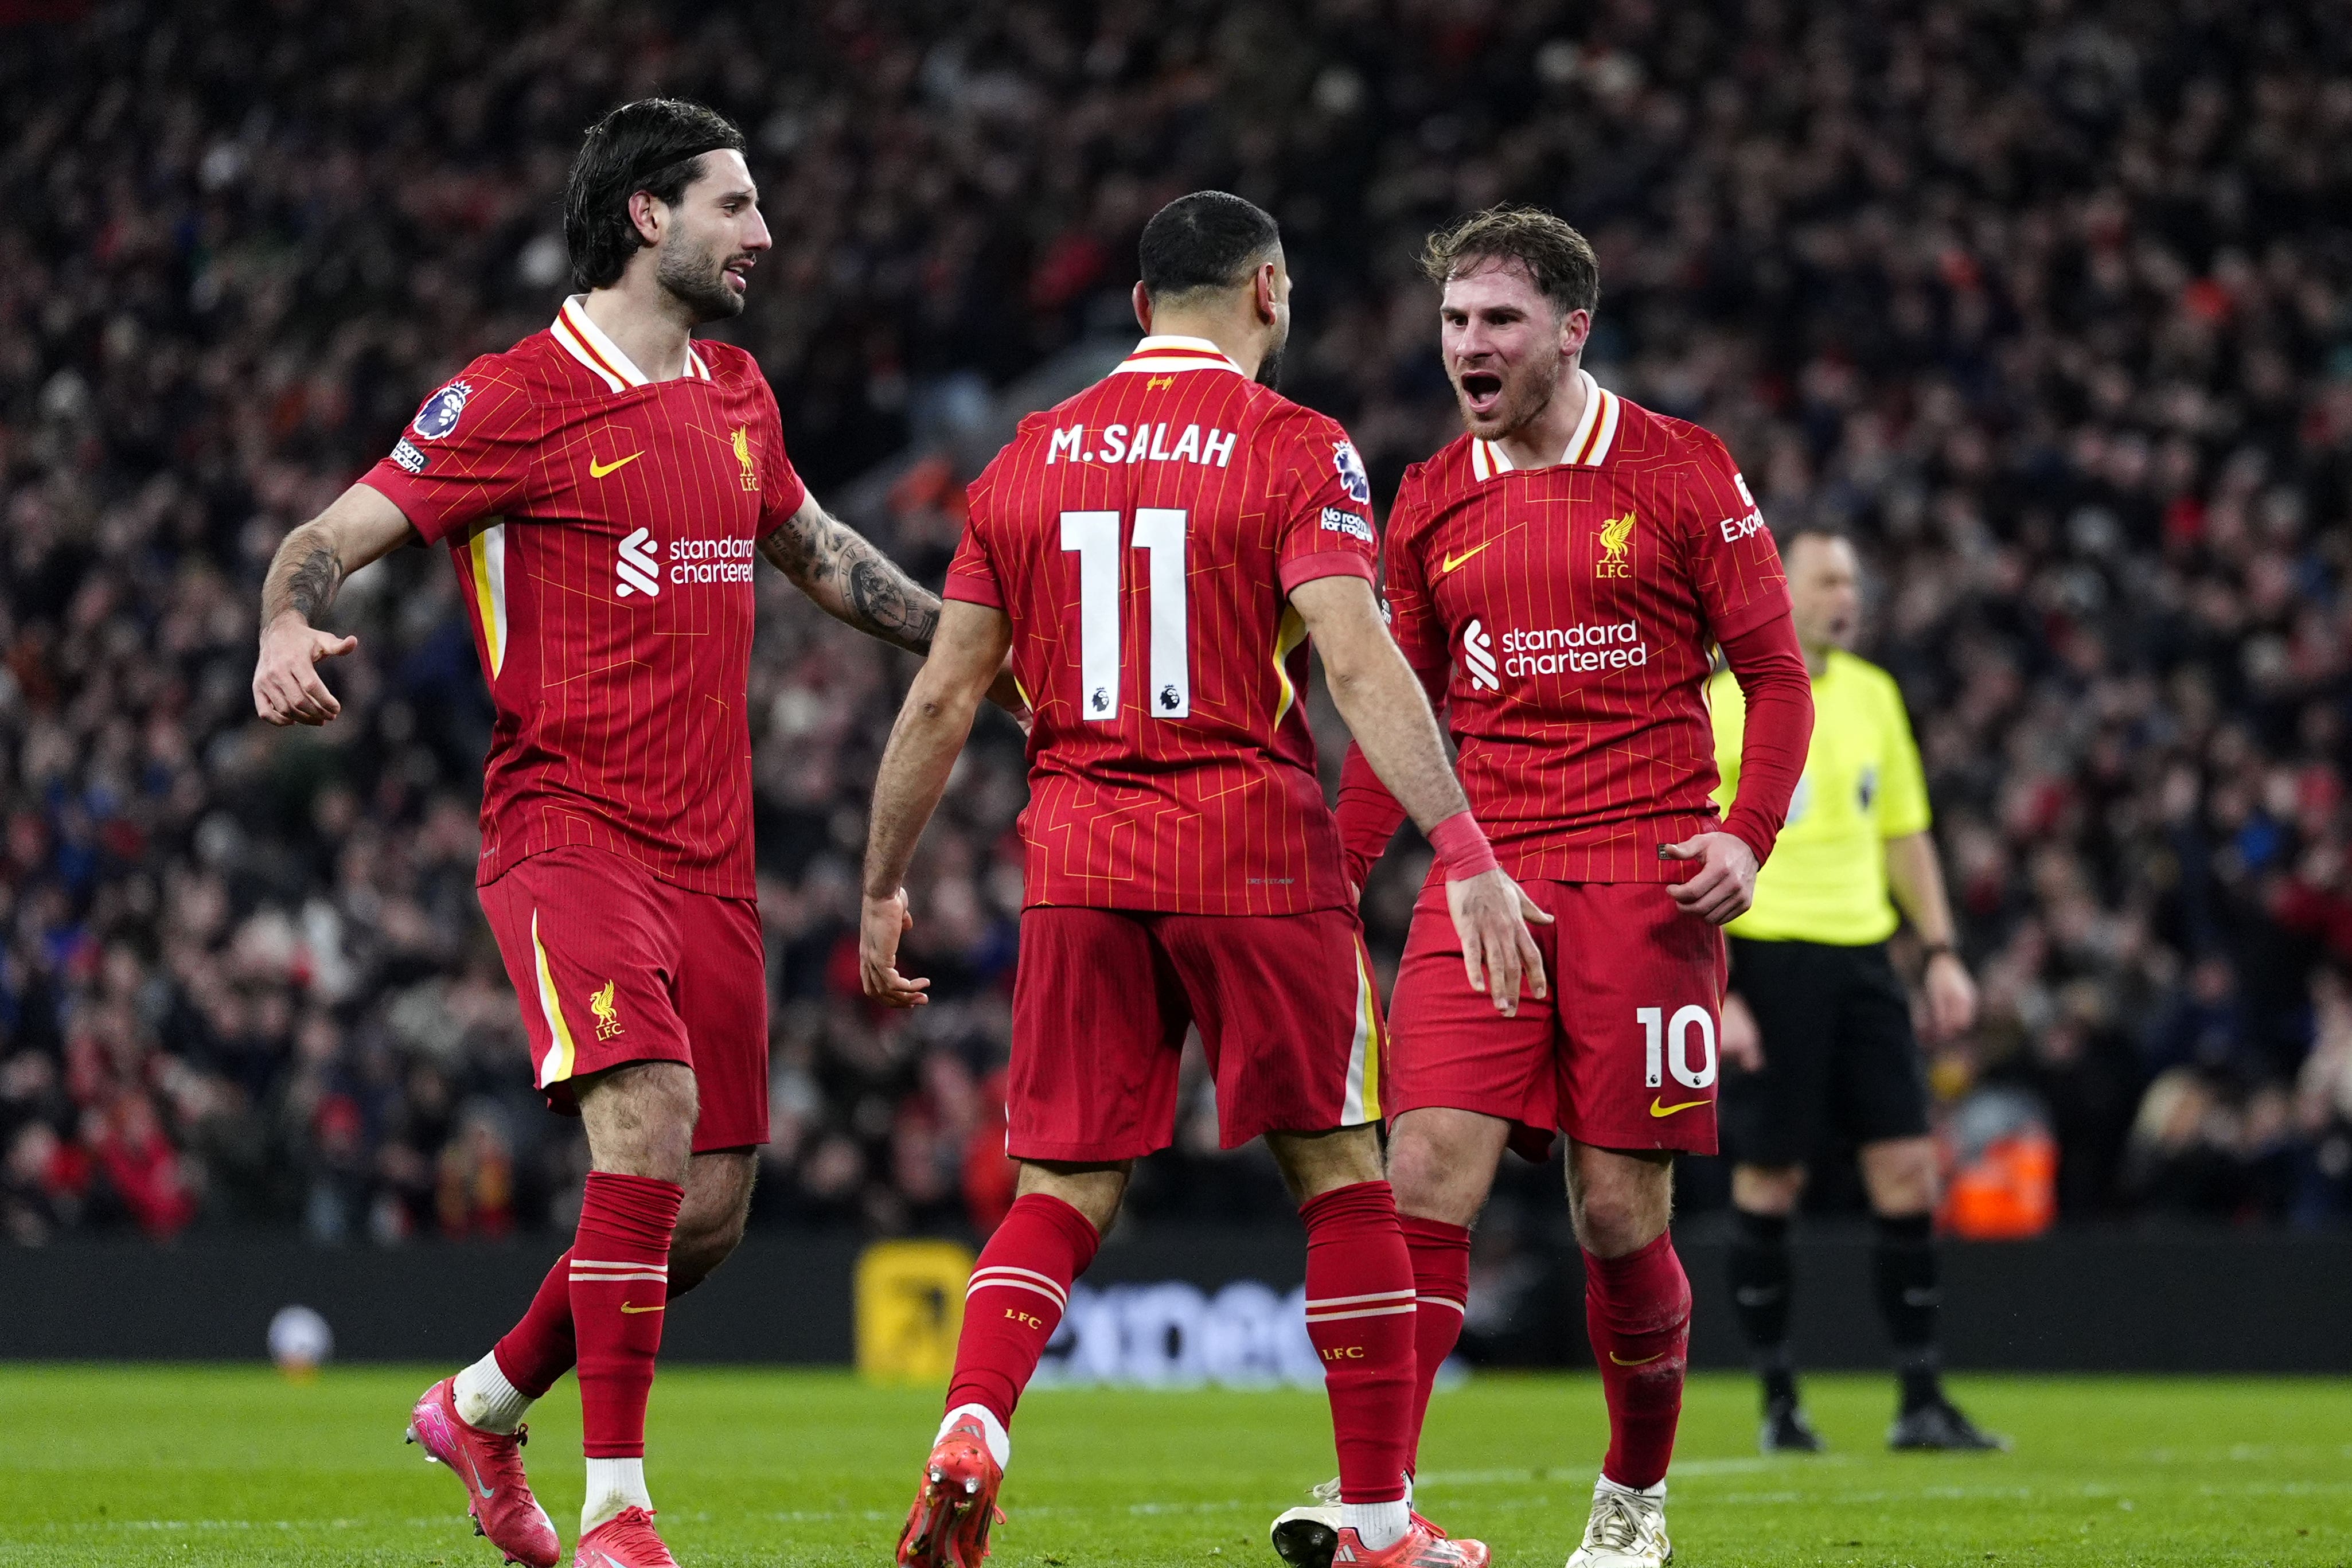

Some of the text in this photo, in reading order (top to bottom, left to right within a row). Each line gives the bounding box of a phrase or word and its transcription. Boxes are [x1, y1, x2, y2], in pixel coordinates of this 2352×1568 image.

[1046, 423, 1237, 468] M.SALAH
[1321, 507, 1341, 522] No
[669, 535, 755, 560] standard
[670, 559, 754, 584] chartered
[1596, 564, 1632, 579] L.F.C.
[1059, 508, 1189, 721] 11
[1502, 619, 1637, 653] standard
[1505, 641, 1647, 677] chartered
[1636, 1004, 1717, 1089] 10
[1004, 1308, 1042, 1330] LFC
[1322, 1346, 1364, 1360] LFC
